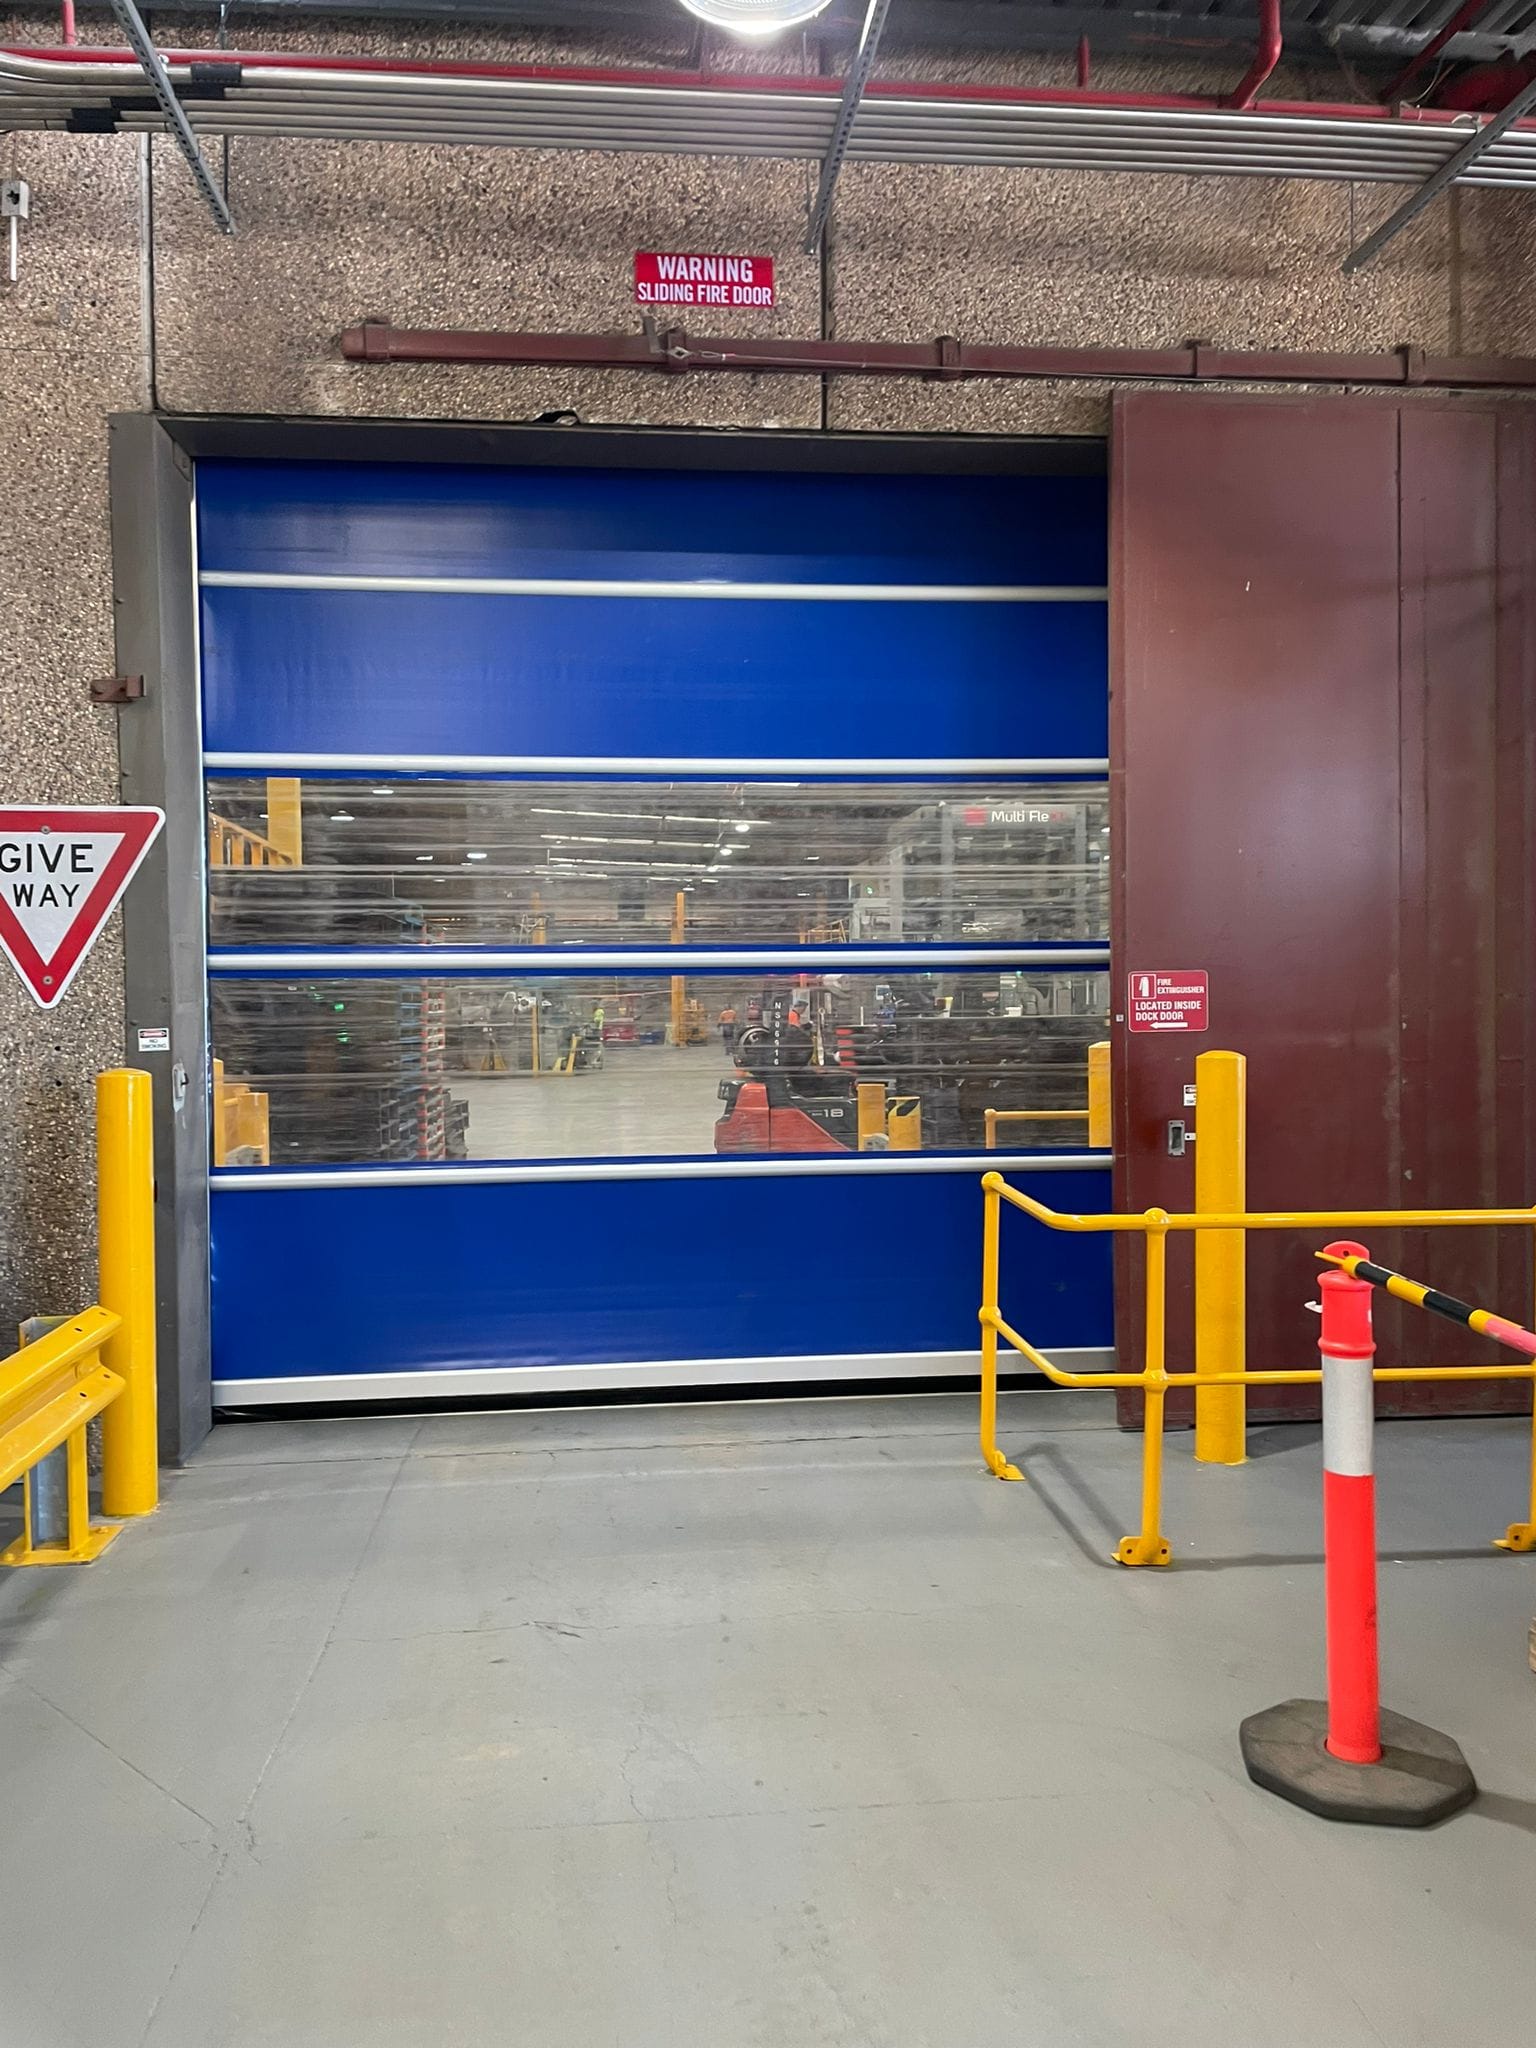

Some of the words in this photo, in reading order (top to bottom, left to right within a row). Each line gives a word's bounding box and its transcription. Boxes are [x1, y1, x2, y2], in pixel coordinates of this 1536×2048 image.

[656, 255, 753, 283] WARNING
[637, 282, 694, 303] SLIDING
[697, 284, 730, 304] FIRE
[733, 286, 772, 305] DOOR
[991, 810, 1025, 823] Multi
[0, 843, 93, 873] GIVE
[13, 883, 80, 907] WAY
[1157, 978, 1172, 986] FIRE
[1157, 986, 1205, 994] EXTINGUISHER
[1135, 1001, 1172, 1011] LOCATED
[1174, 1000, 1202, 1010] INSIDE
[1135, 1012, 1158, 1021] DOCK
[1160, 1011, 1184, 1020] DOOR
[824, 1108, 844, 1118] 18
